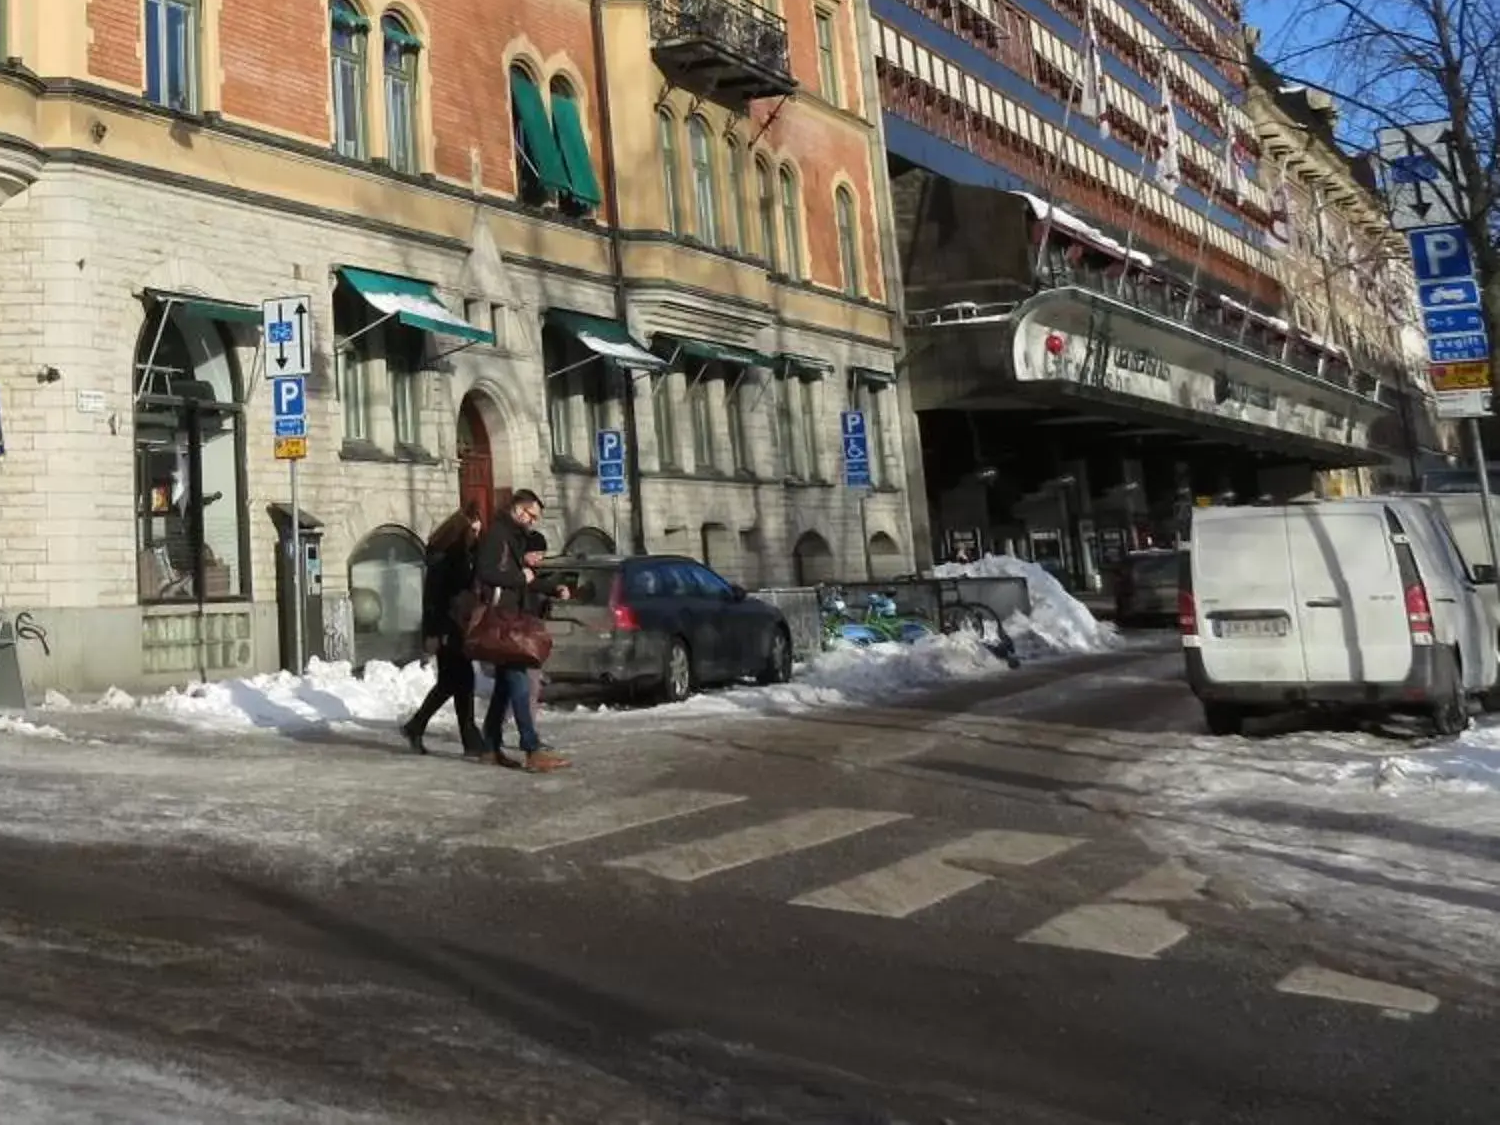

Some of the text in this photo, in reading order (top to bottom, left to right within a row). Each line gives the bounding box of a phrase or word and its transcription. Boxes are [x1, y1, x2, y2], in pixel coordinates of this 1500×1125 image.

[1424, 232, 1459, 275] P
[281, 382, 299, 413] P
[847, 414, 861, 433] P
[604, 434, 617, 459] P
